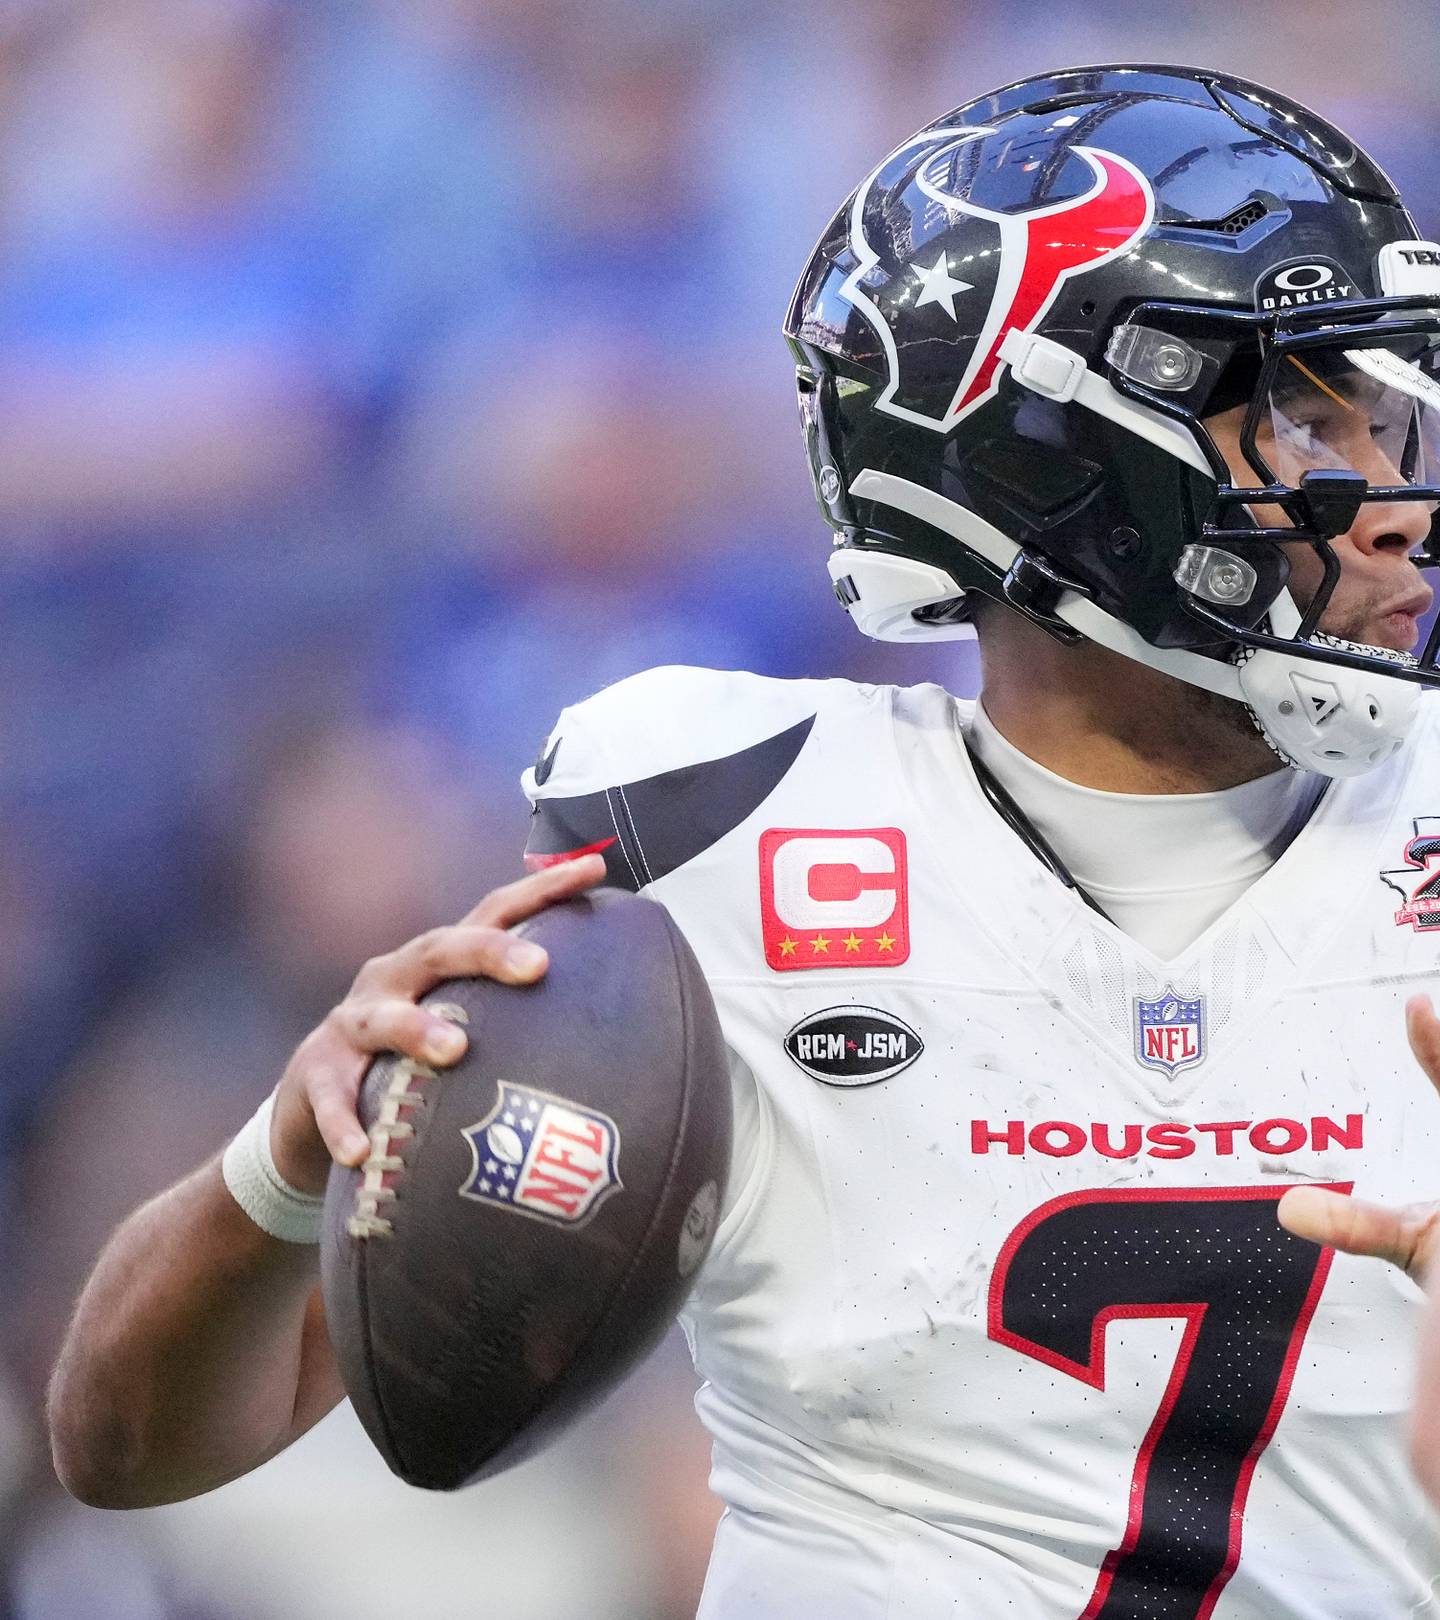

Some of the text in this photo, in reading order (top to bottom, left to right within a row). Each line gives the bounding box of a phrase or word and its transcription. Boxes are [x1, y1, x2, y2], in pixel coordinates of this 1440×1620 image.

[1263, 286, 1351, 309] OAKLEY
[773, 837, 897, 930] C
[797, 1033, 906, 1060] RCM JSM
[1146, 1027, 1196, 1062] NFL
[970, 1114, 1363, 1159] HOUSTON
[521, 1120, 604, 1215] NFL
[987, 1181, 1355, 1620] 7
